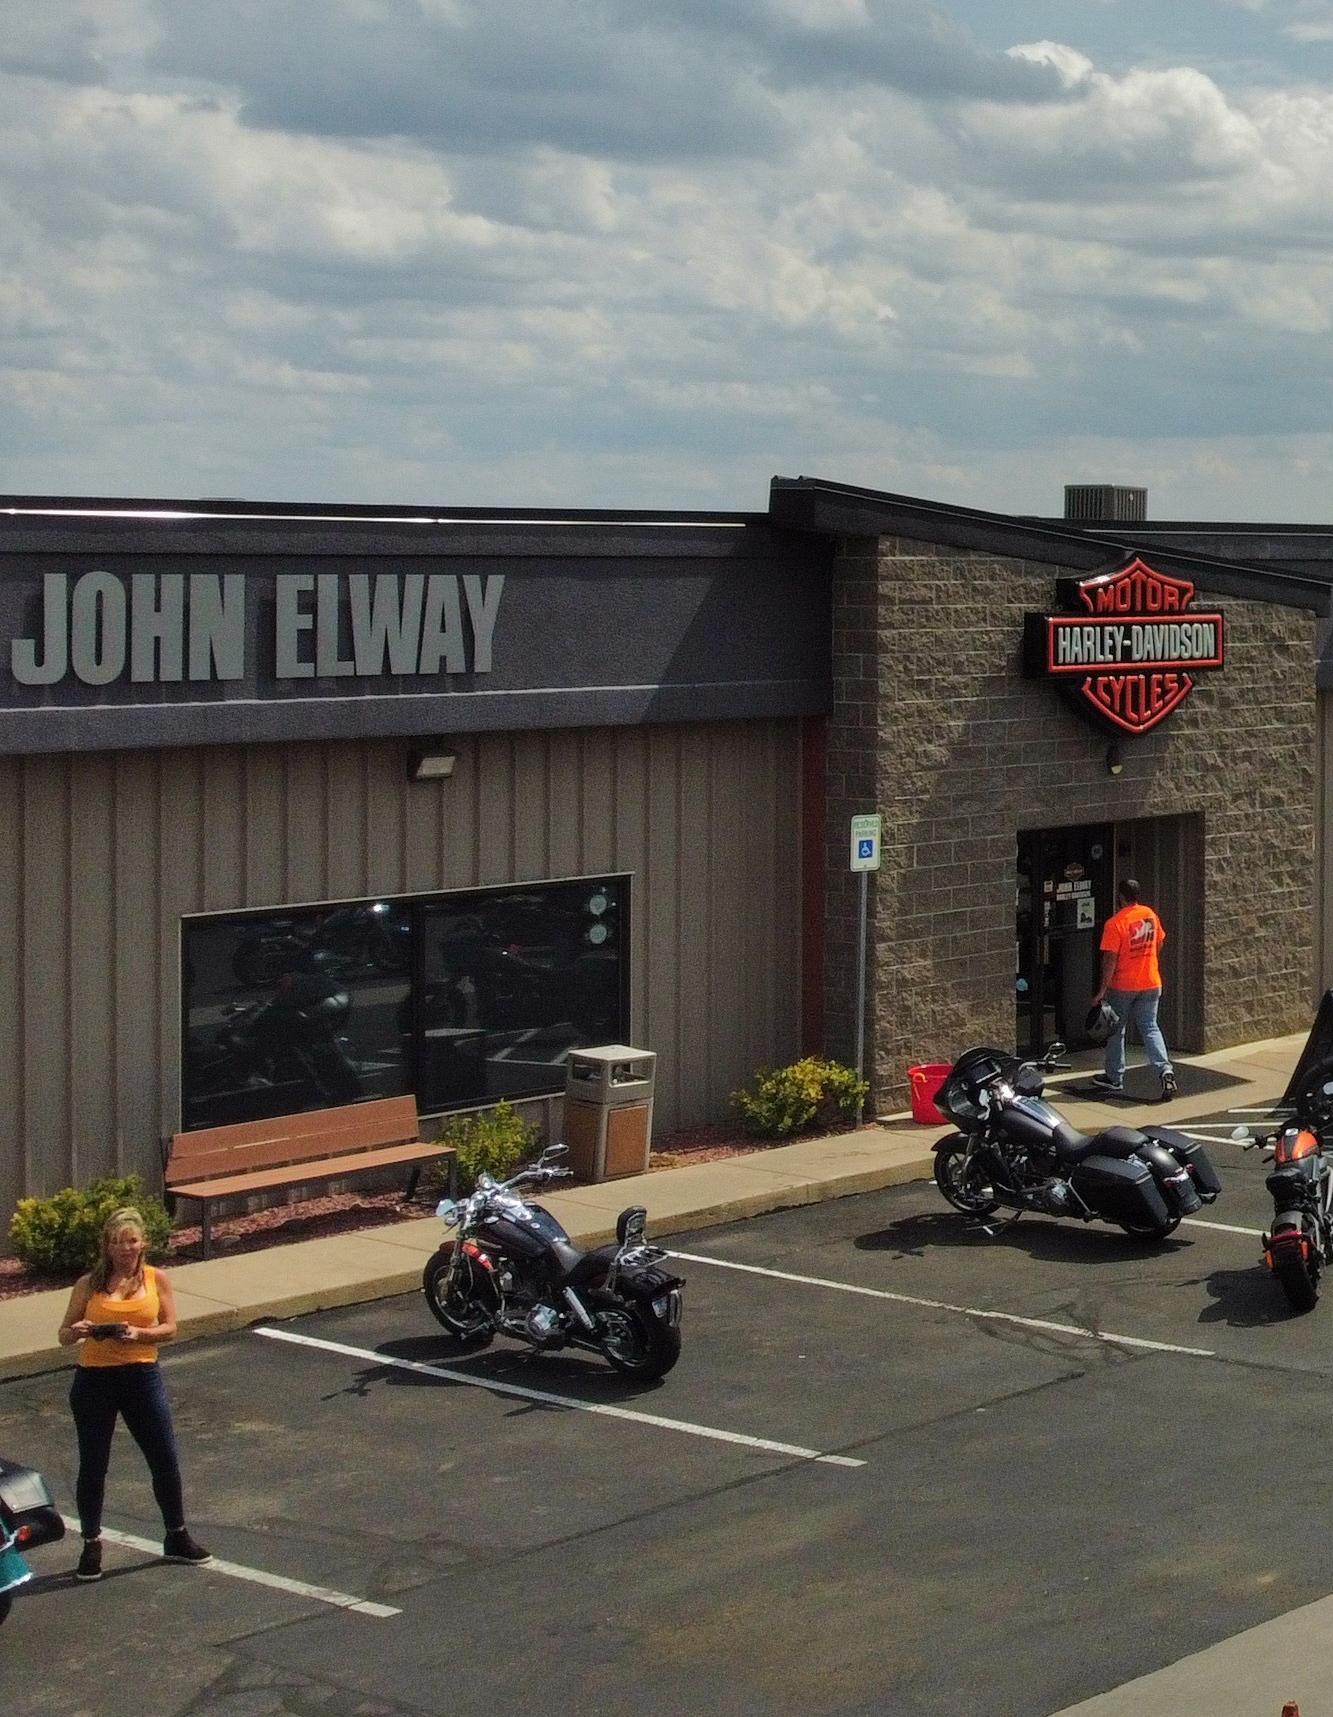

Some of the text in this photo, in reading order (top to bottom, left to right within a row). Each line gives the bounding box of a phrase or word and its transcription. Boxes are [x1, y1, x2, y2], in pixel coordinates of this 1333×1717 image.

[1096, 570, 1180, 613] MOTOR
[11, 571, 506, 686] JOHN ELWAY
[1057, 623, 1216, 664] HARLEY-DAVIDSON
[1096, 673, 1180, 722] CYCLES
